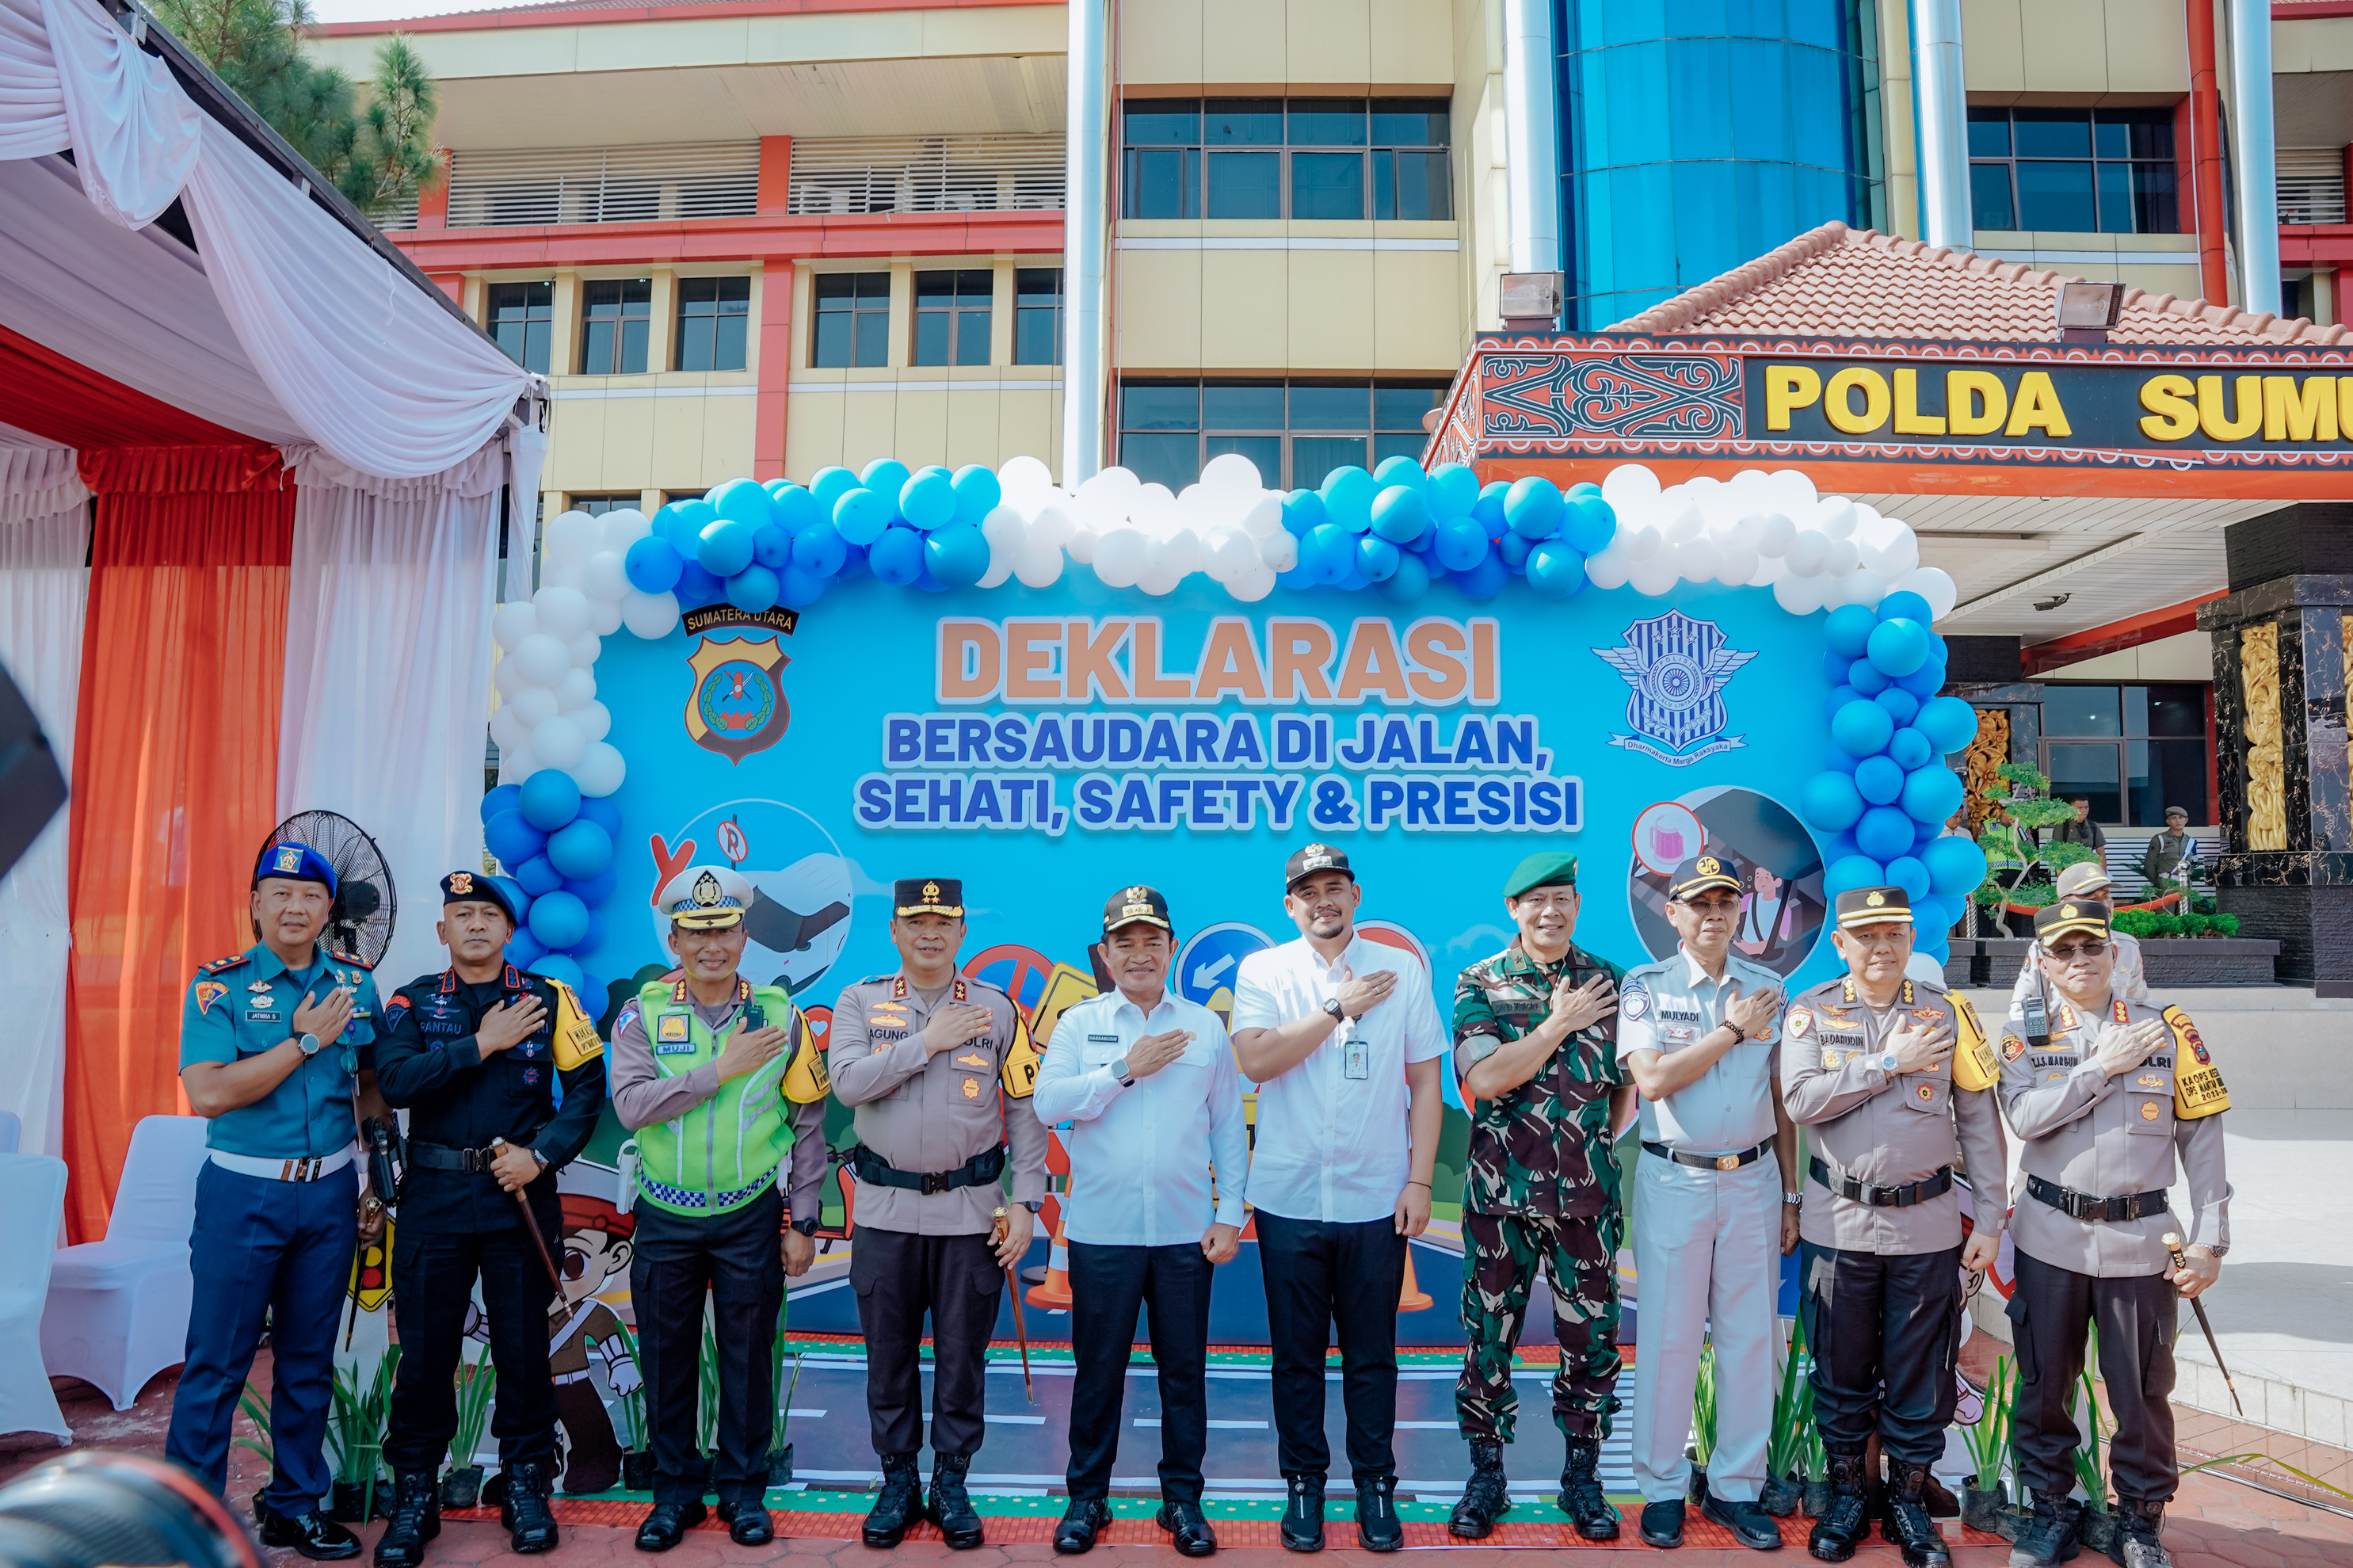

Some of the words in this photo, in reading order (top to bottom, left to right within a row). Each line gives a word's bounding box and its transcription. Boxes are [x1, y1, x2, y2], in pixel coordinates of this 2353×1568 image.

[1765, 365, 2073, 437] POLDA
[2140, 374, 2353, 441] SUM
[687, 609, 751, 630] SUMATERA
[754, 609, 791, 630] UTARA
[941, 622, 1494, 700] DEKLARASI
[1659, 656, 1692, 666] POLISI
[1657, 695, 1672, 707] LALU
[1674, 696, 1695, 708] LINTAS
[888, 719, 1263, 763] BERSAUDARA
[1277, 719, 1327, 763] DI
[1341, 720, 1547, 771] JALAN,
[1672, 756, 1694, 765] Marga
[1694, 743, 1728, 759] Raksyaka
[859, 779, 1063, 830] SEHATI,
[1079, 779, 1299, 824] SAFETY
[1314, 780, 1355, 825] &
[1371, 781, 1577, 826] PRESISI
[1661, 1010, 1699, 1022] MULYADI
[420, 1021, 462, 1035] RANTAU
[870, 1028, 909, 1040] AGUNG
[963, 1037, 993, 1050] OLRI
[1820, 1032, 1863, 1047] BADARUDIN
[662, 1044, 690, 1053] MUJI
[2181, 1071, 2209, 1088] KAOPS
